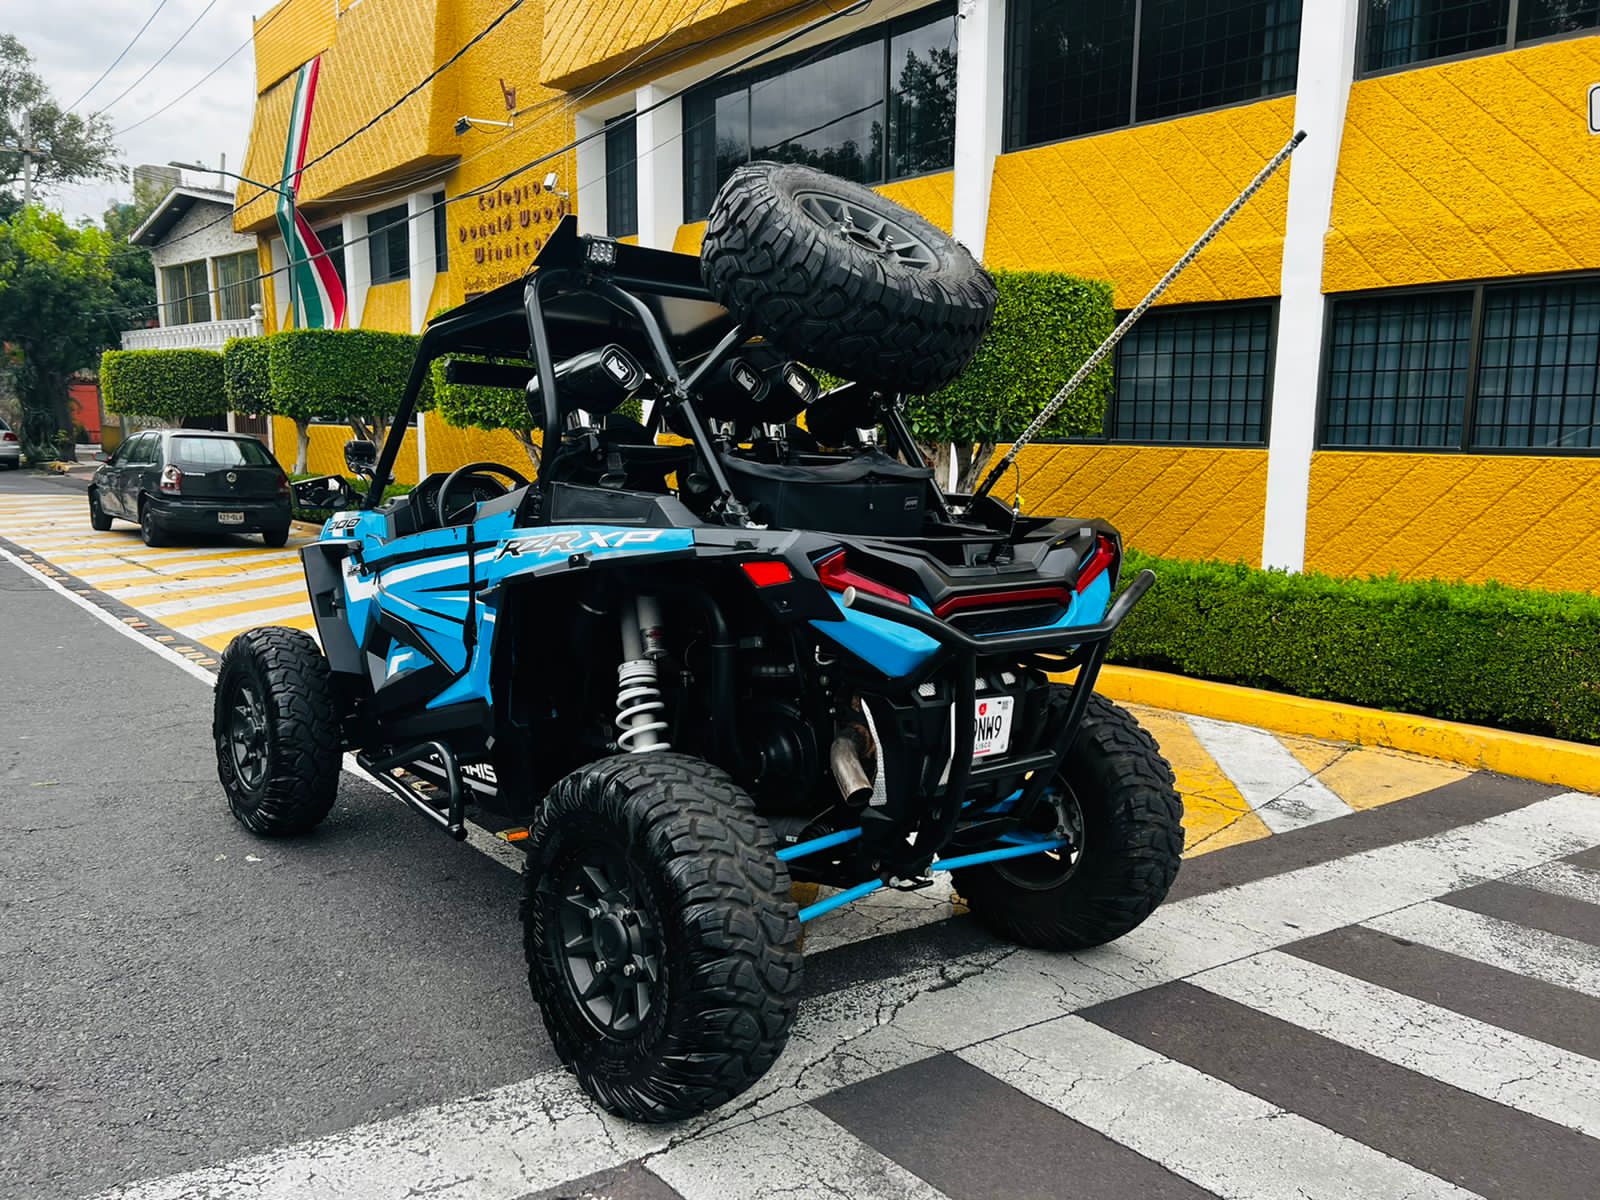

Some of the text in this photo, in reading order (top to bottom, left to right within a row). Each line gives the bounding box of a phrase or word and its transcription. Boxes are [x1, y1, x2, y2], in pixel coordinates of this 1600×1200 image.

[478, 182, 541, 211] Colegio
[459, 213, 512, 243] Donald
[475, 233, 550, 264] Winnico
[494, 529, 664, 562] RZR XP
